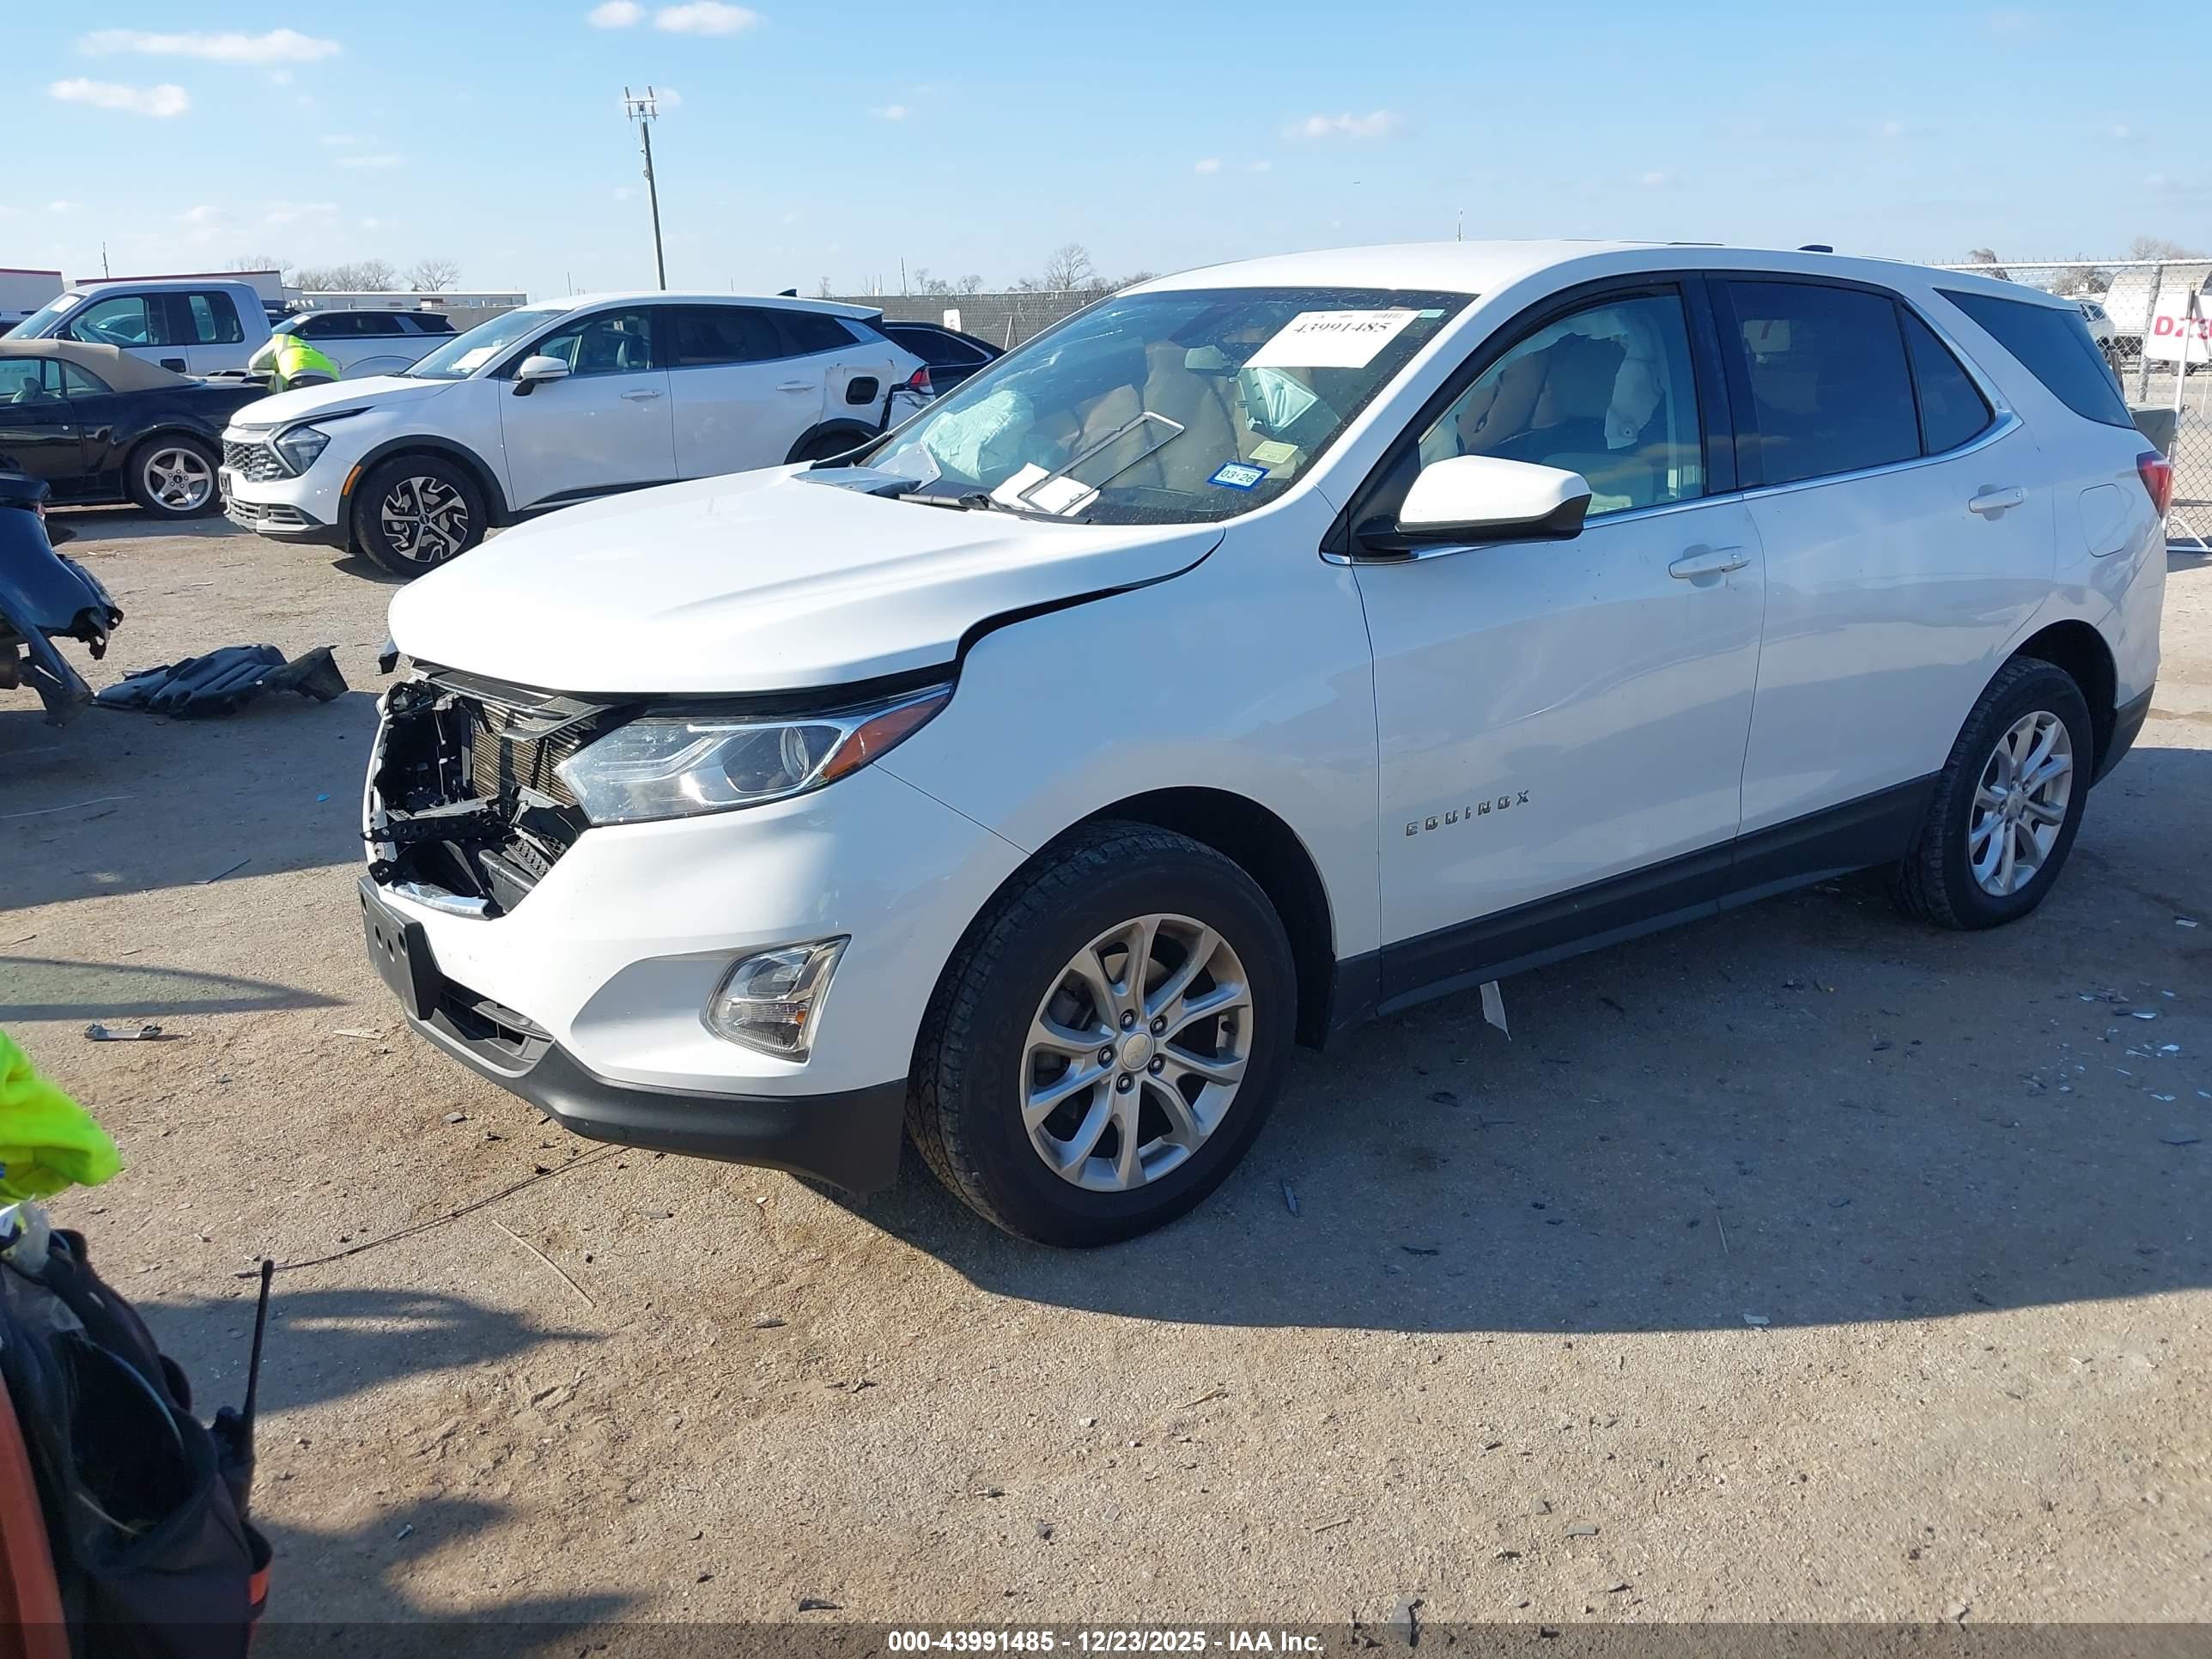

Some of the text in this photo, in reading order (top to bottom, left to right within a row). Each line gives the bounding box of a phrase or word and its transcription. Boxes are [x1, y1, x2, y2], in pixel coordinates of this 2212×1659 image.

[1220, 470, 1256, 483] 03 26
[1406, 789, 1529, 836] EQUINOX
